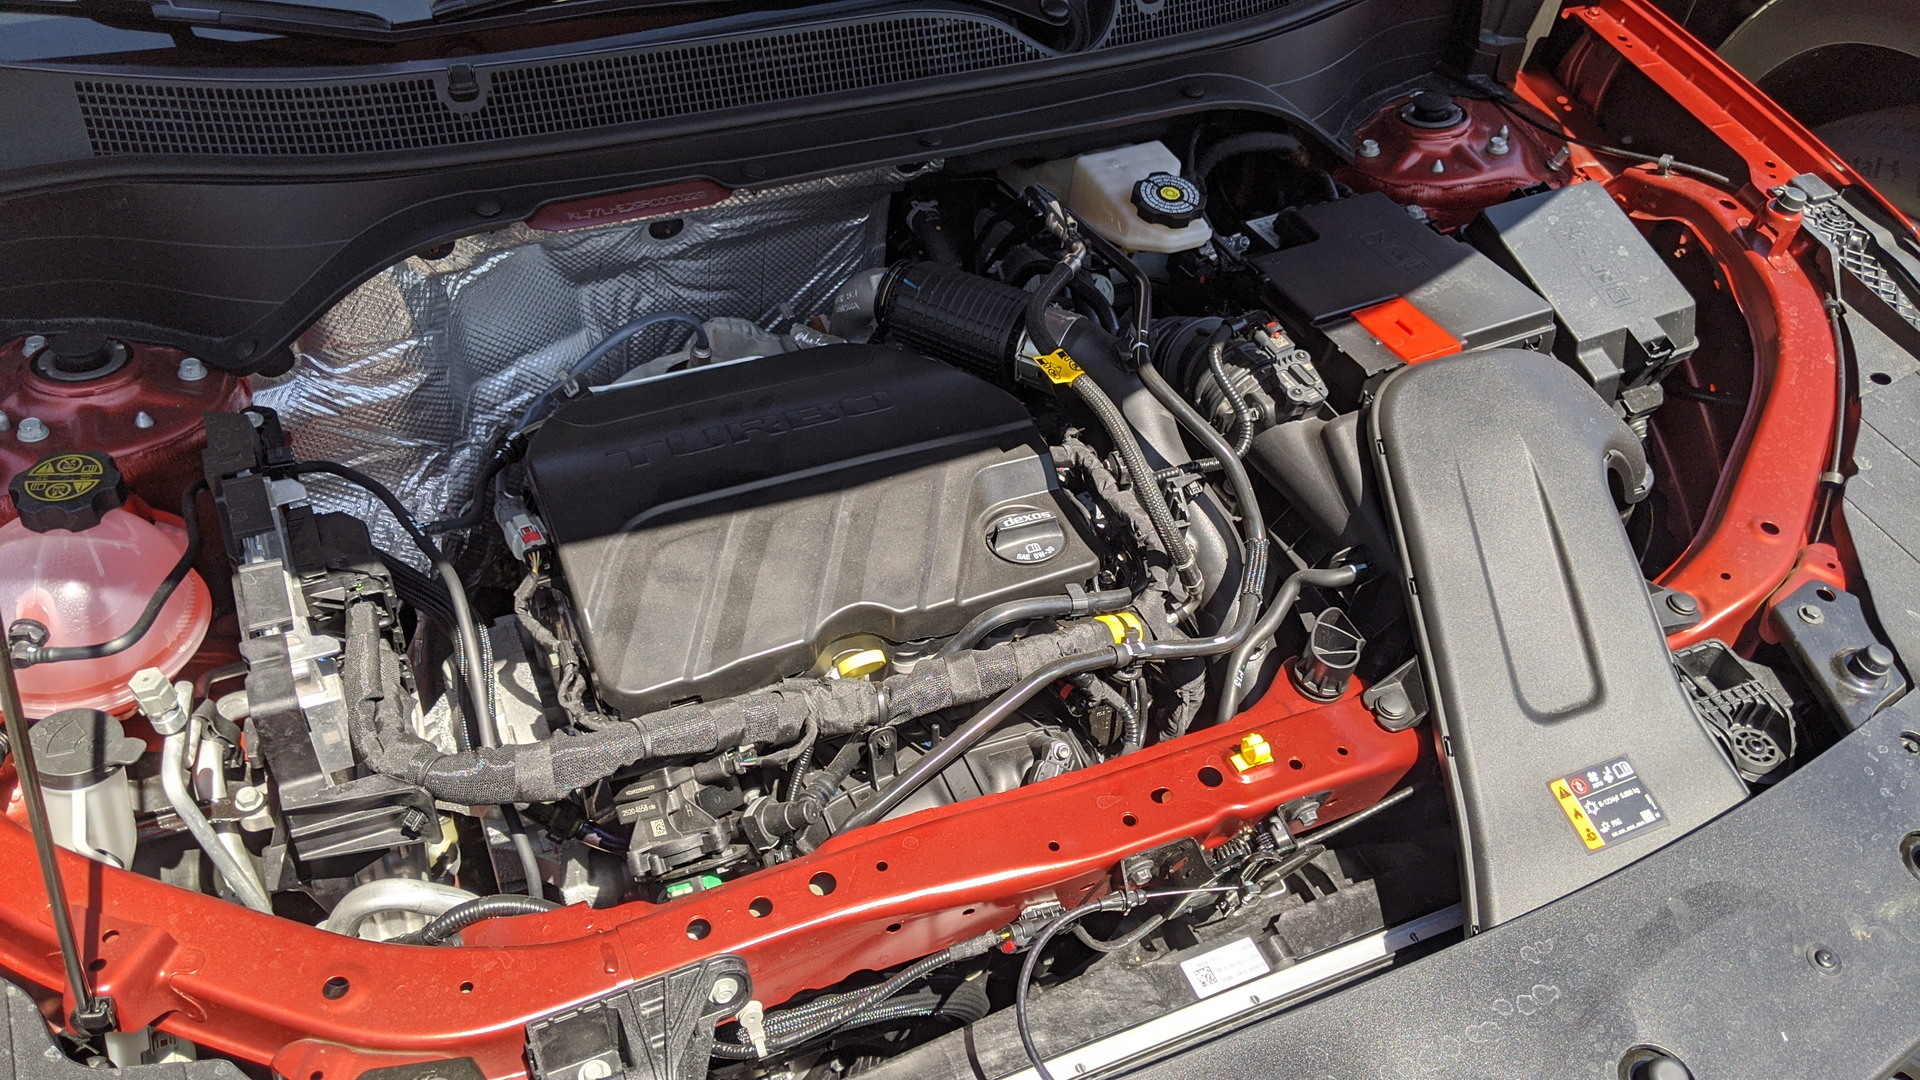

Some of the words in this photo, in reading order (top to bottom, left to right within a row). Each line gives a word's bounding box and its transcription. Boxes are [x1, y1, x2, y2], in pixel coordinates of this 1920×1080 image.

[605, 390, 897, 469] TURBO
[1003, 511, 1052, 527] dexos
[1033, 545, 1055, 560] 5W-30
